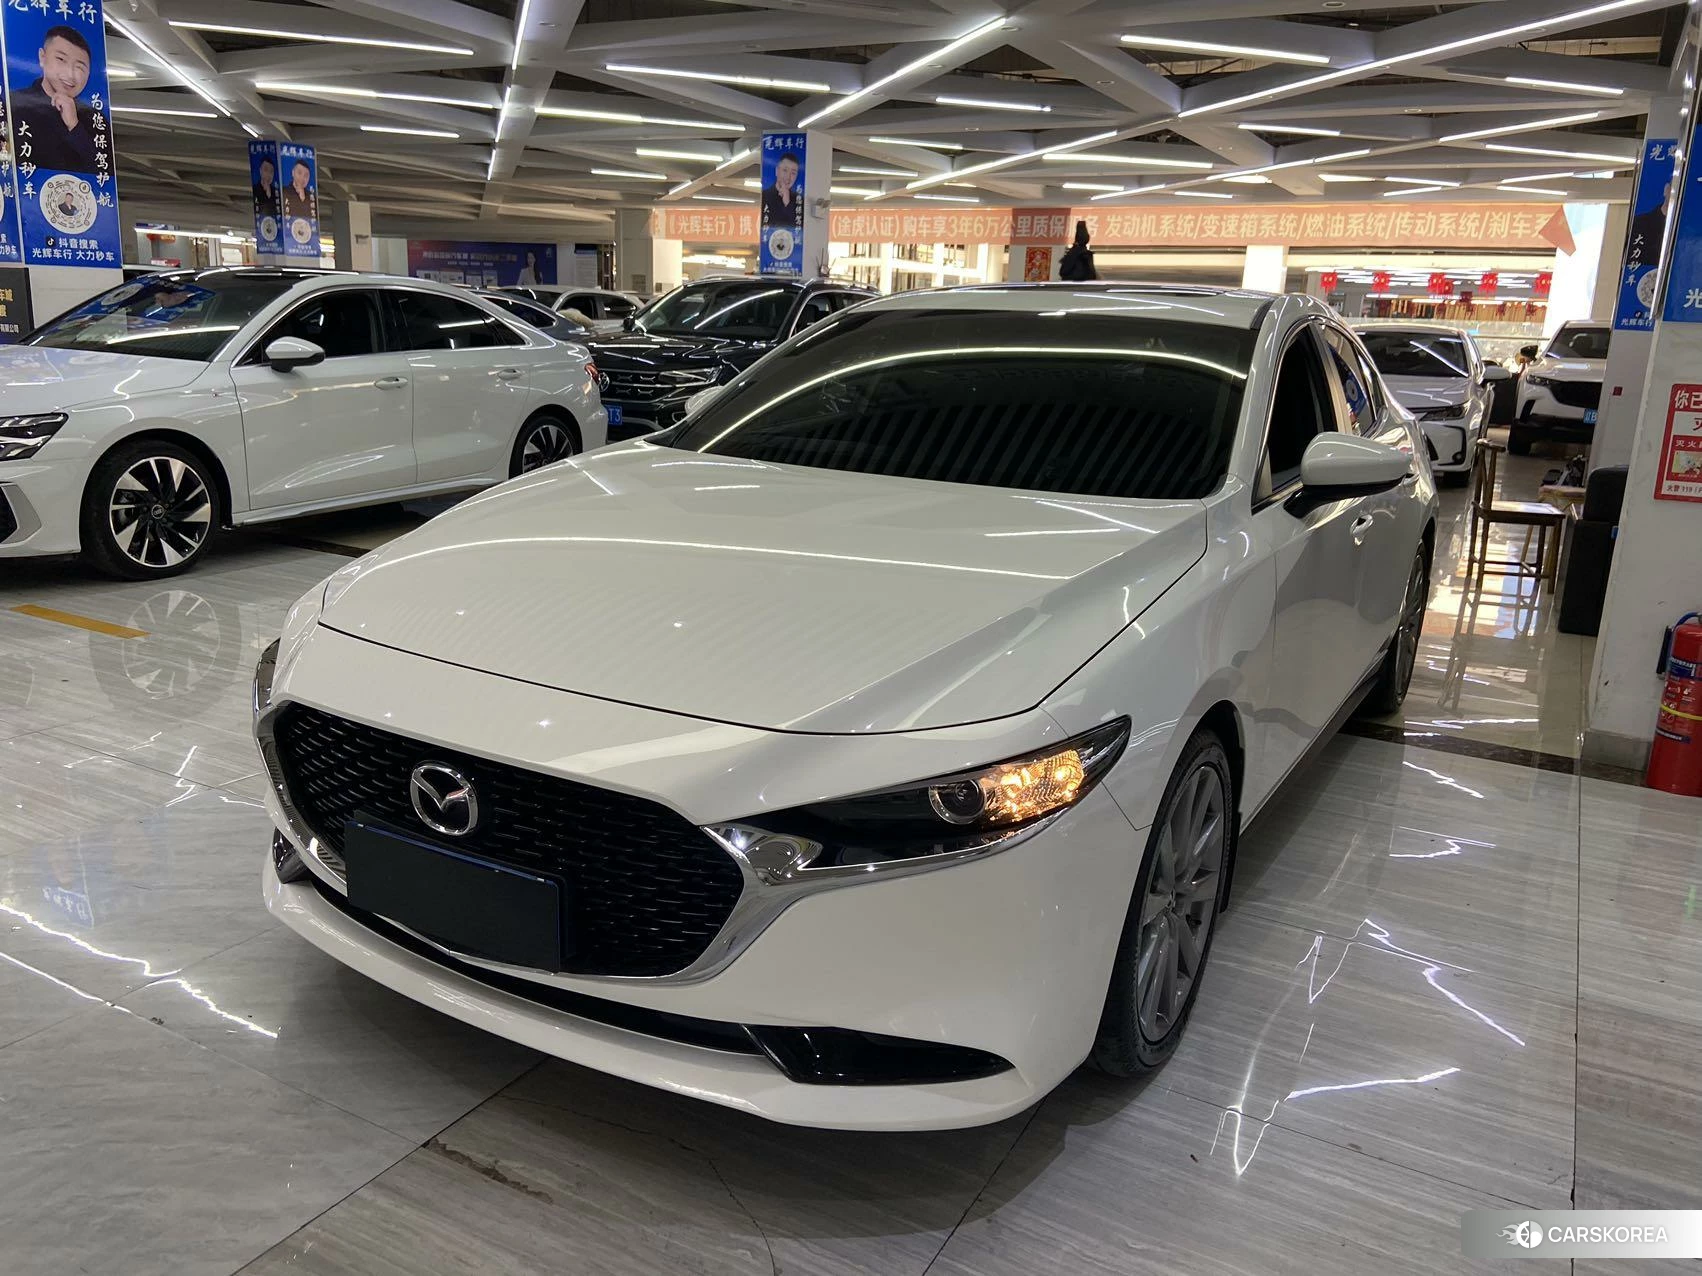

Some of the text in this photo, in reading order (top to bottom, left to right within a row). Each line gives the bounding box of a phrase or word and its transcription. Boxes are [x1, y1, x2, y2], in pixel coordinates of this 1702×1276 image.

[18, 121, 37, 199] 大力秒车
[91, 93, 114, 207] 为您保驾护航
[32, 247, 115, 262] 光辉车行 大力秒车
[58, 237, 99, 250] 抖音搜索
